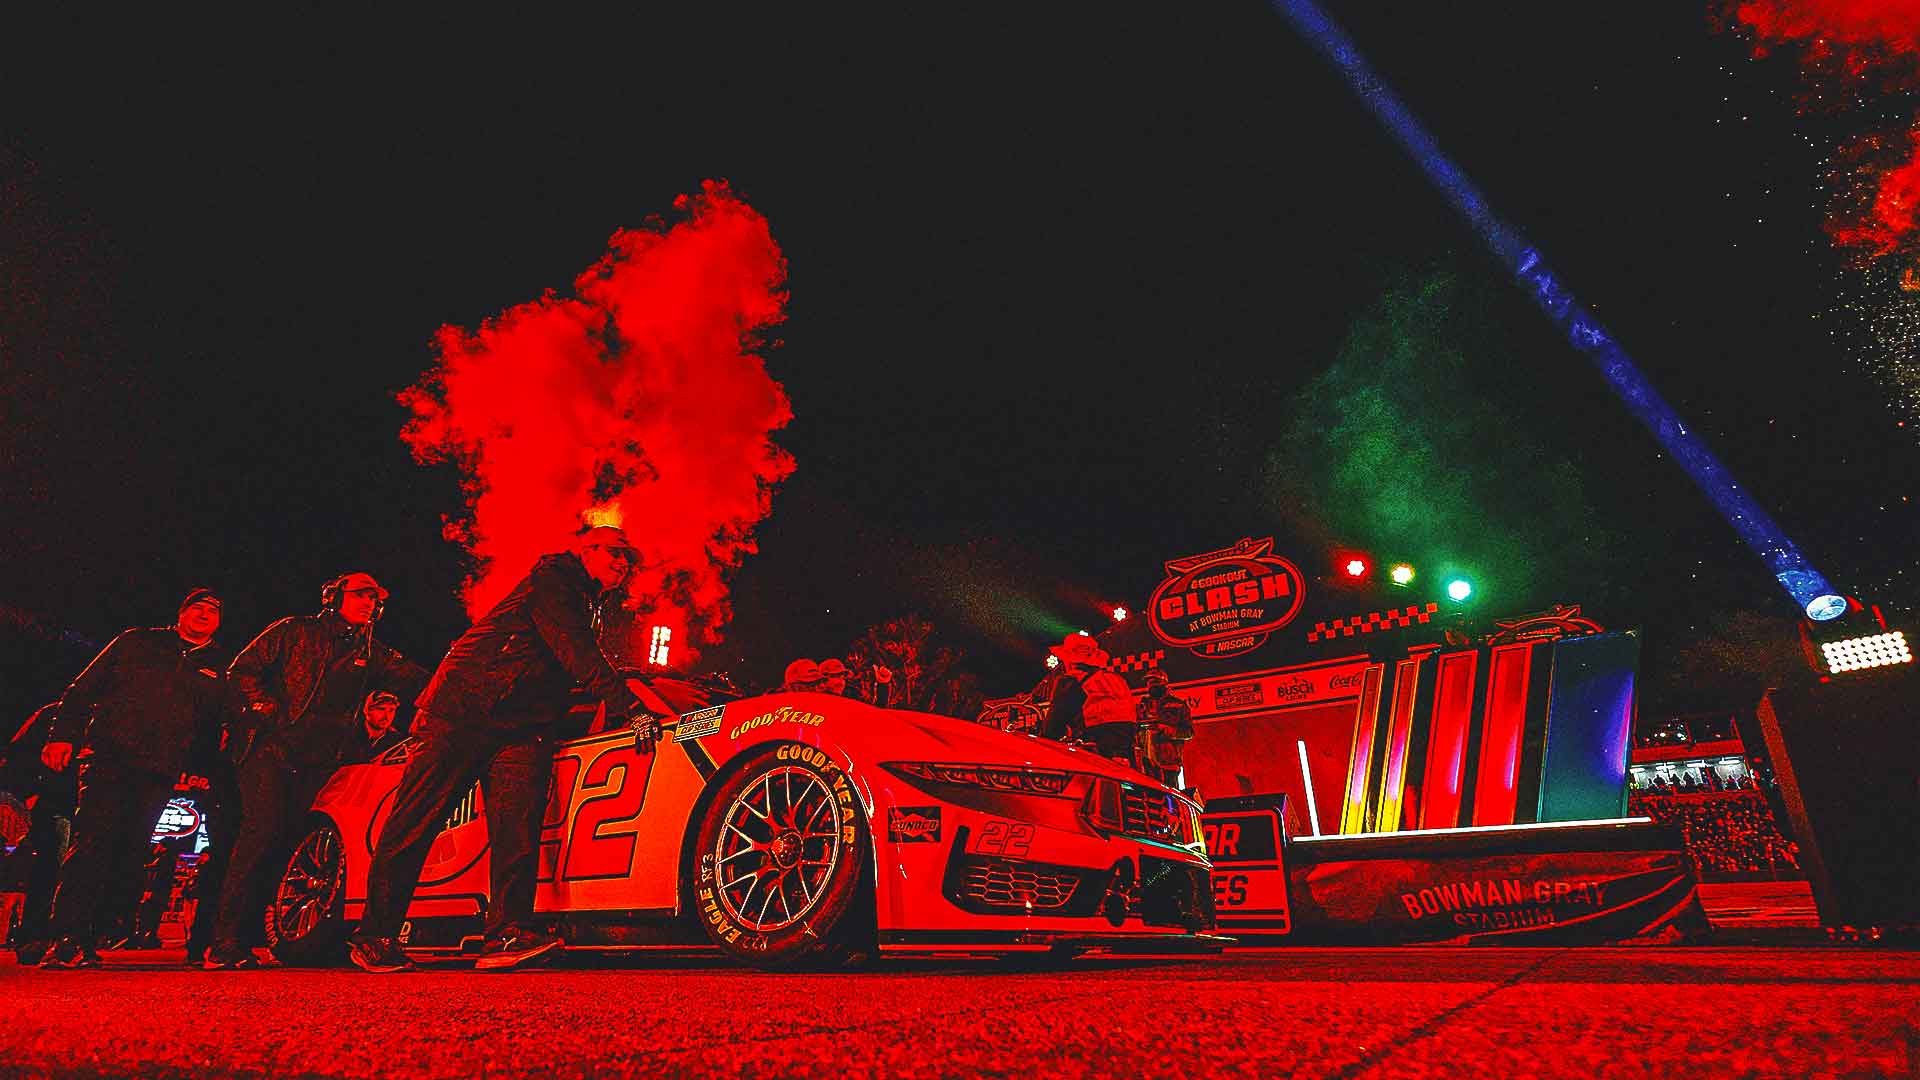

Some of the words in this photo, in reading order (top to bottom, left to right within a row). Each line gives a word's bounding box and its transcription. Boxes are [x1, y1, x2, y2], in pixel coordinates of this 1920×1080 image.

[1160, 573, 1290, 620] CLASH
[1188, 620, 1200, 632] AT
[1200, 609, 1238, 627] BOWMAN
[1240, 608, 1264, 619] GRAY
[1212, 620, 1240, 632] STADIUM
[1217, 636, 1255, 652] NASCAR
[1277, 681, 1315, 698] BUSCH
[730, 706, 825, 740] GOODYEAR
[776, 744, 855, 845] GOODYEAR
[890, 819, 940, 832] SUNOCO
[976, 820, 1036, 857] 22
[701, 853, 714, 882] RF3
[700, 887, 742, 943] EAGLE
[1401, 879, 1521, 920] BOWMAN
[1533, 880, 1606, 906] GRAY
